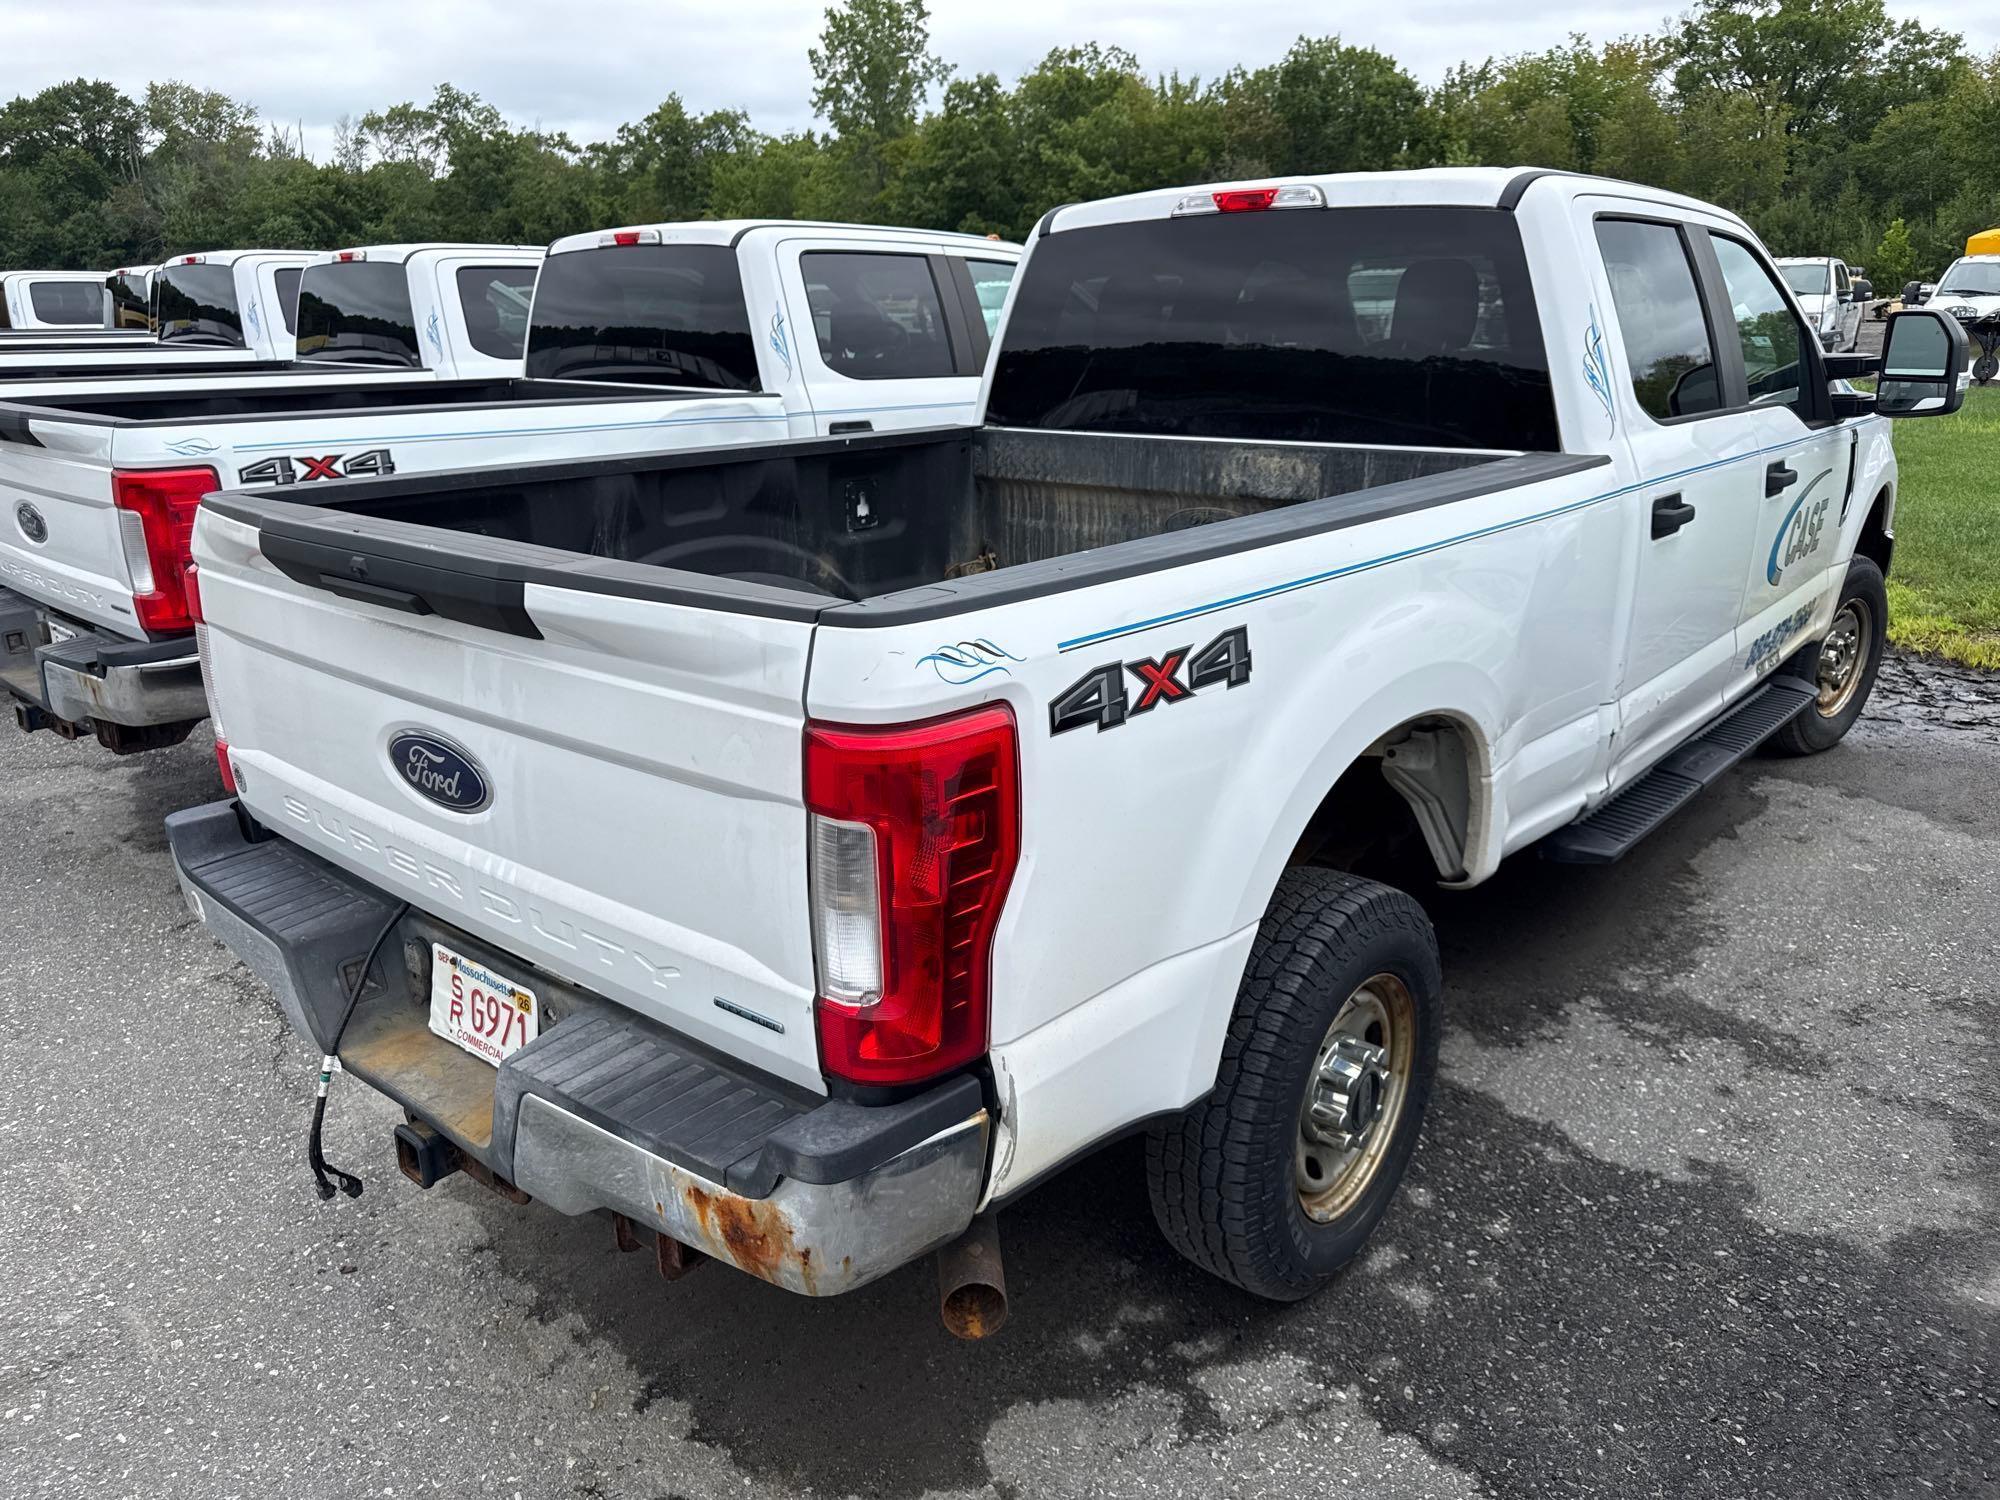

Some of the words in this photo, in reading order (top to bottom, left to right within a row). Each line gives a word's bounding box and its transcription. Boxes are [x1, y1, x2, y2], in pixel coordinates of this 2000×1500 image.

[1784, 497, 1830, 568] CASE
[0, 561, 46, 588] UPER
[47, 577, 104, 608] DUTY
[406, 746, 462, 799] Ford
[283, 794, 464, 900] SUPER
[479, 885, 681, 990] DUTY
[438, 950, 450, 964] SEP
[518, 996, 530, 1011] 26
[456, 1029, 505, 1062] COMMERCIAL
